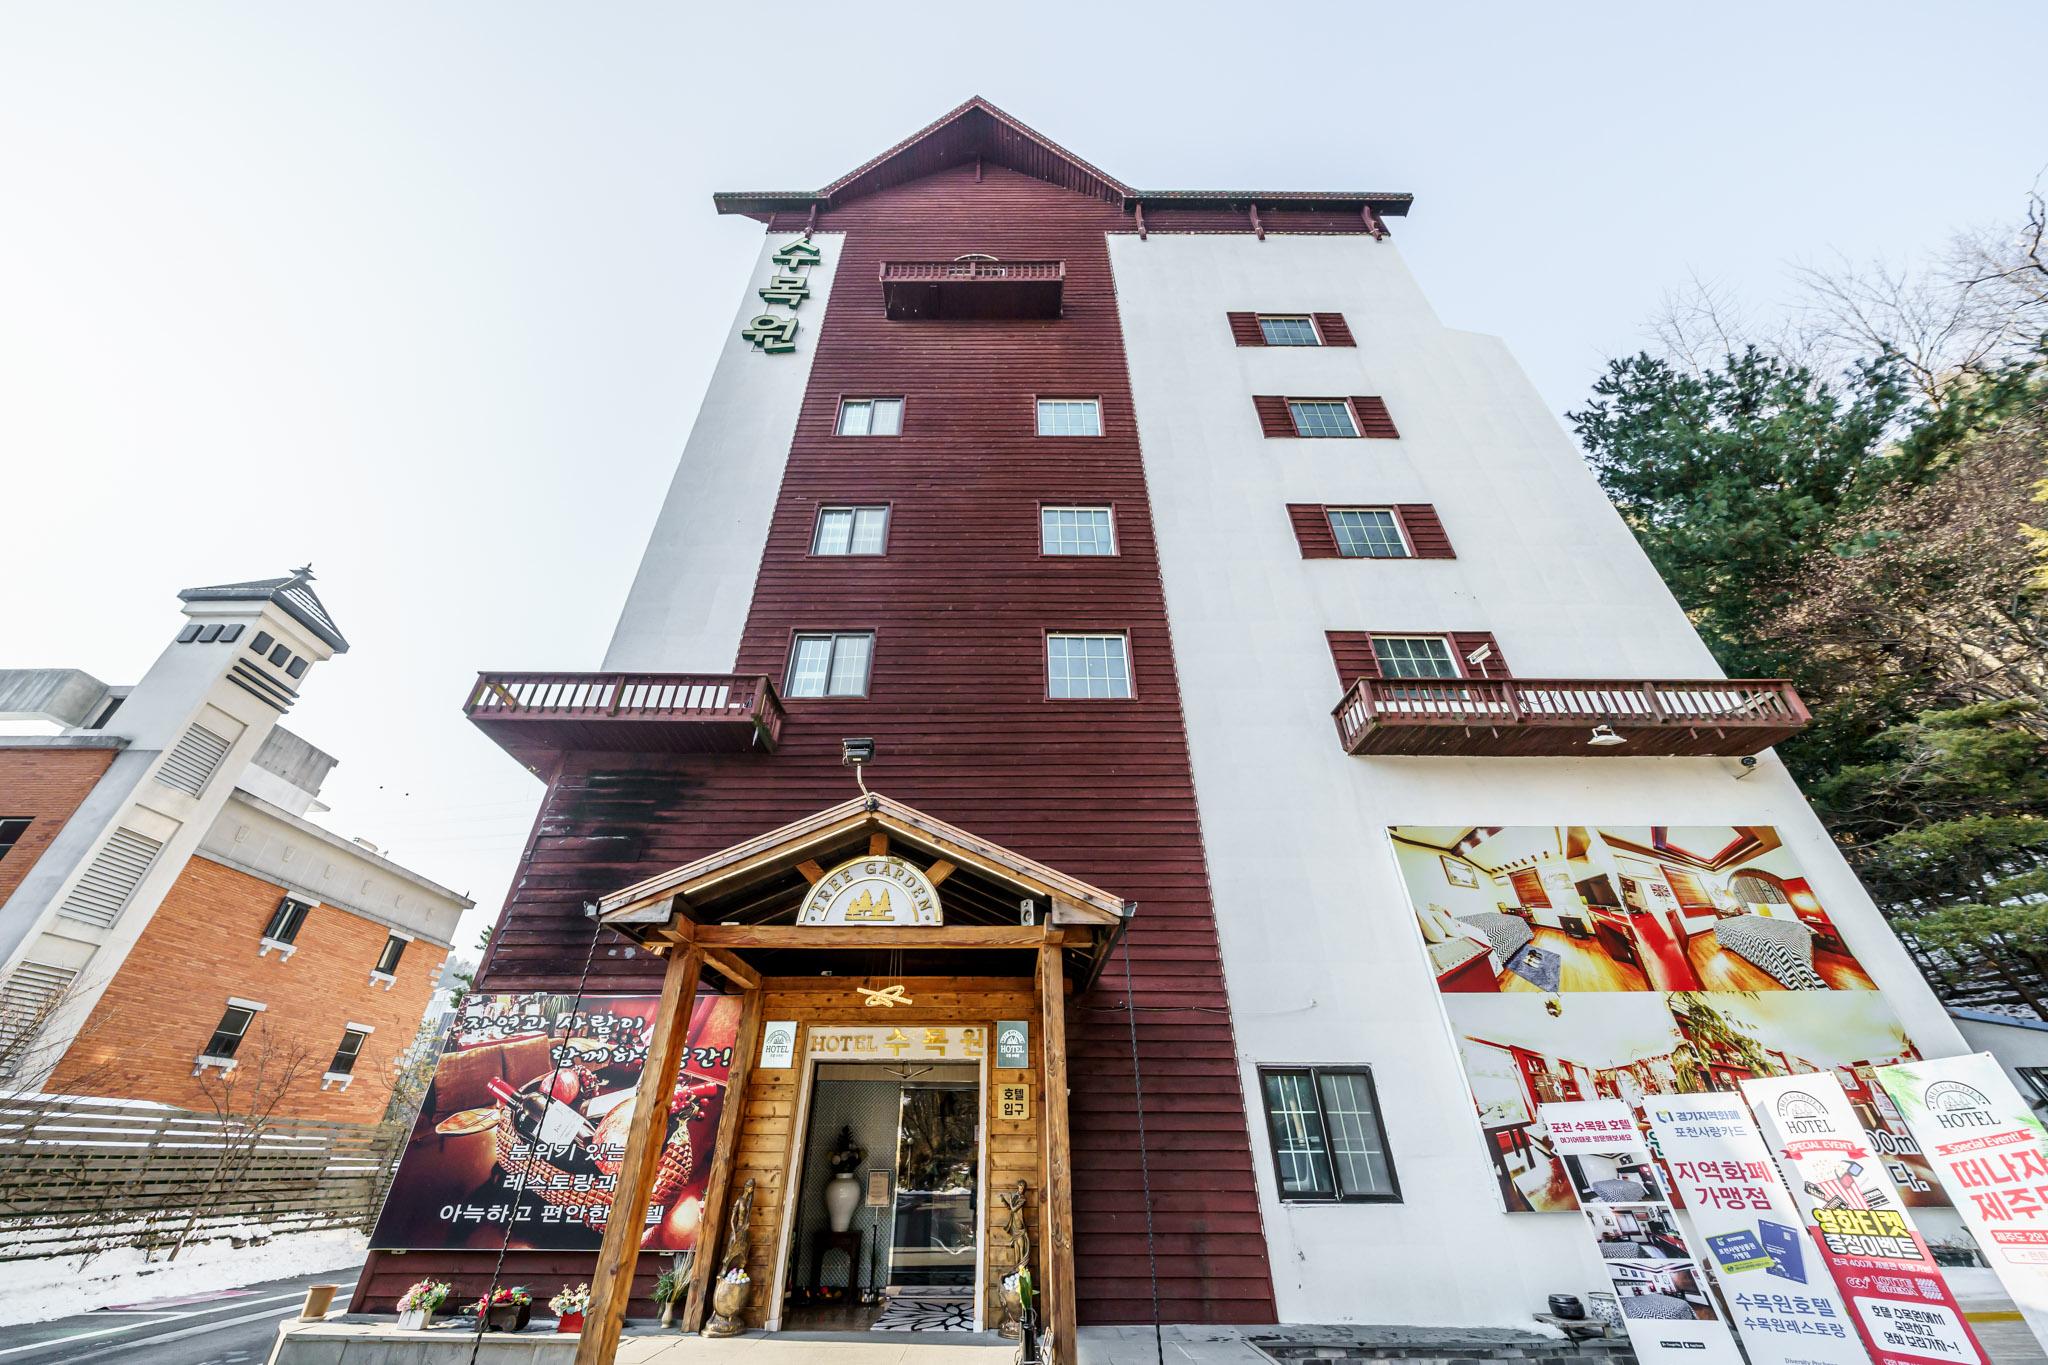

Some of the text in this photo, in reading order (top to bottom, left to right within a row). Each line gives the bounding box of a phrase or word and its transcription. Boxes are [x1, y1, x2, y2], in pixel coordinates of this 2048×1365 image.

[742, 237, 821, 354] 수목원
[810, 862, 933, 913] TREE GARDEN
[464, 1016, 644, 1034] 자연과 사람이
[765, 1045, 789, 1054] HOTEL
[810, 1034, 878, 1051] HOTEL
[883, 1028, 983, 1056] 수목원
[1000, 1045, 1024, 1053] HOTEL
[1004, 1088, 1024, 1101] 호텔
[1004, 1103, 1024, 1116] 입구
[1676, 1110, 1741, 1121] 경기지역화폐
[1551, 1119, 1632, 1133] 포천 수목원 호텔
[1785, 1119, 1836, 1134] HOTEL
[1936, 1110, 2001, 1129] HOTEL
[1674, 1126, 1747, 1138] 포천사랑카드
[508, 1144, 626, 1161] 분위기 있는
[1788, 1141, 1853, 1151] SPECIAL EVENT
[1948, 1137, 1986, 1154] Special
[1674, 1161, 1774, 1184] 지역화폐
[502, 1174, 618, 1192] 레스토랑과
[1695, 1186, 1772, 1210] 가맹점
[439, 1205, 532, 1223] 아늑하고
[540, 1205, 611, 1223] 편안한
[1812, 1208, 1911, 1237] 영화티켓
[1824, 1233, 1924, 1259] 증정이벤트
[1736, 1292, 1836, 1318] 수목원호텔
[1871, 1305, 1945, 1325] 호텔 수목원에서
[1744, 1316, 1847, 1339] 수목원레스토랑
[1894, 1321, 1934, 1336] 숙박하고
[1884, 1332, 1905, 1345] 영화
